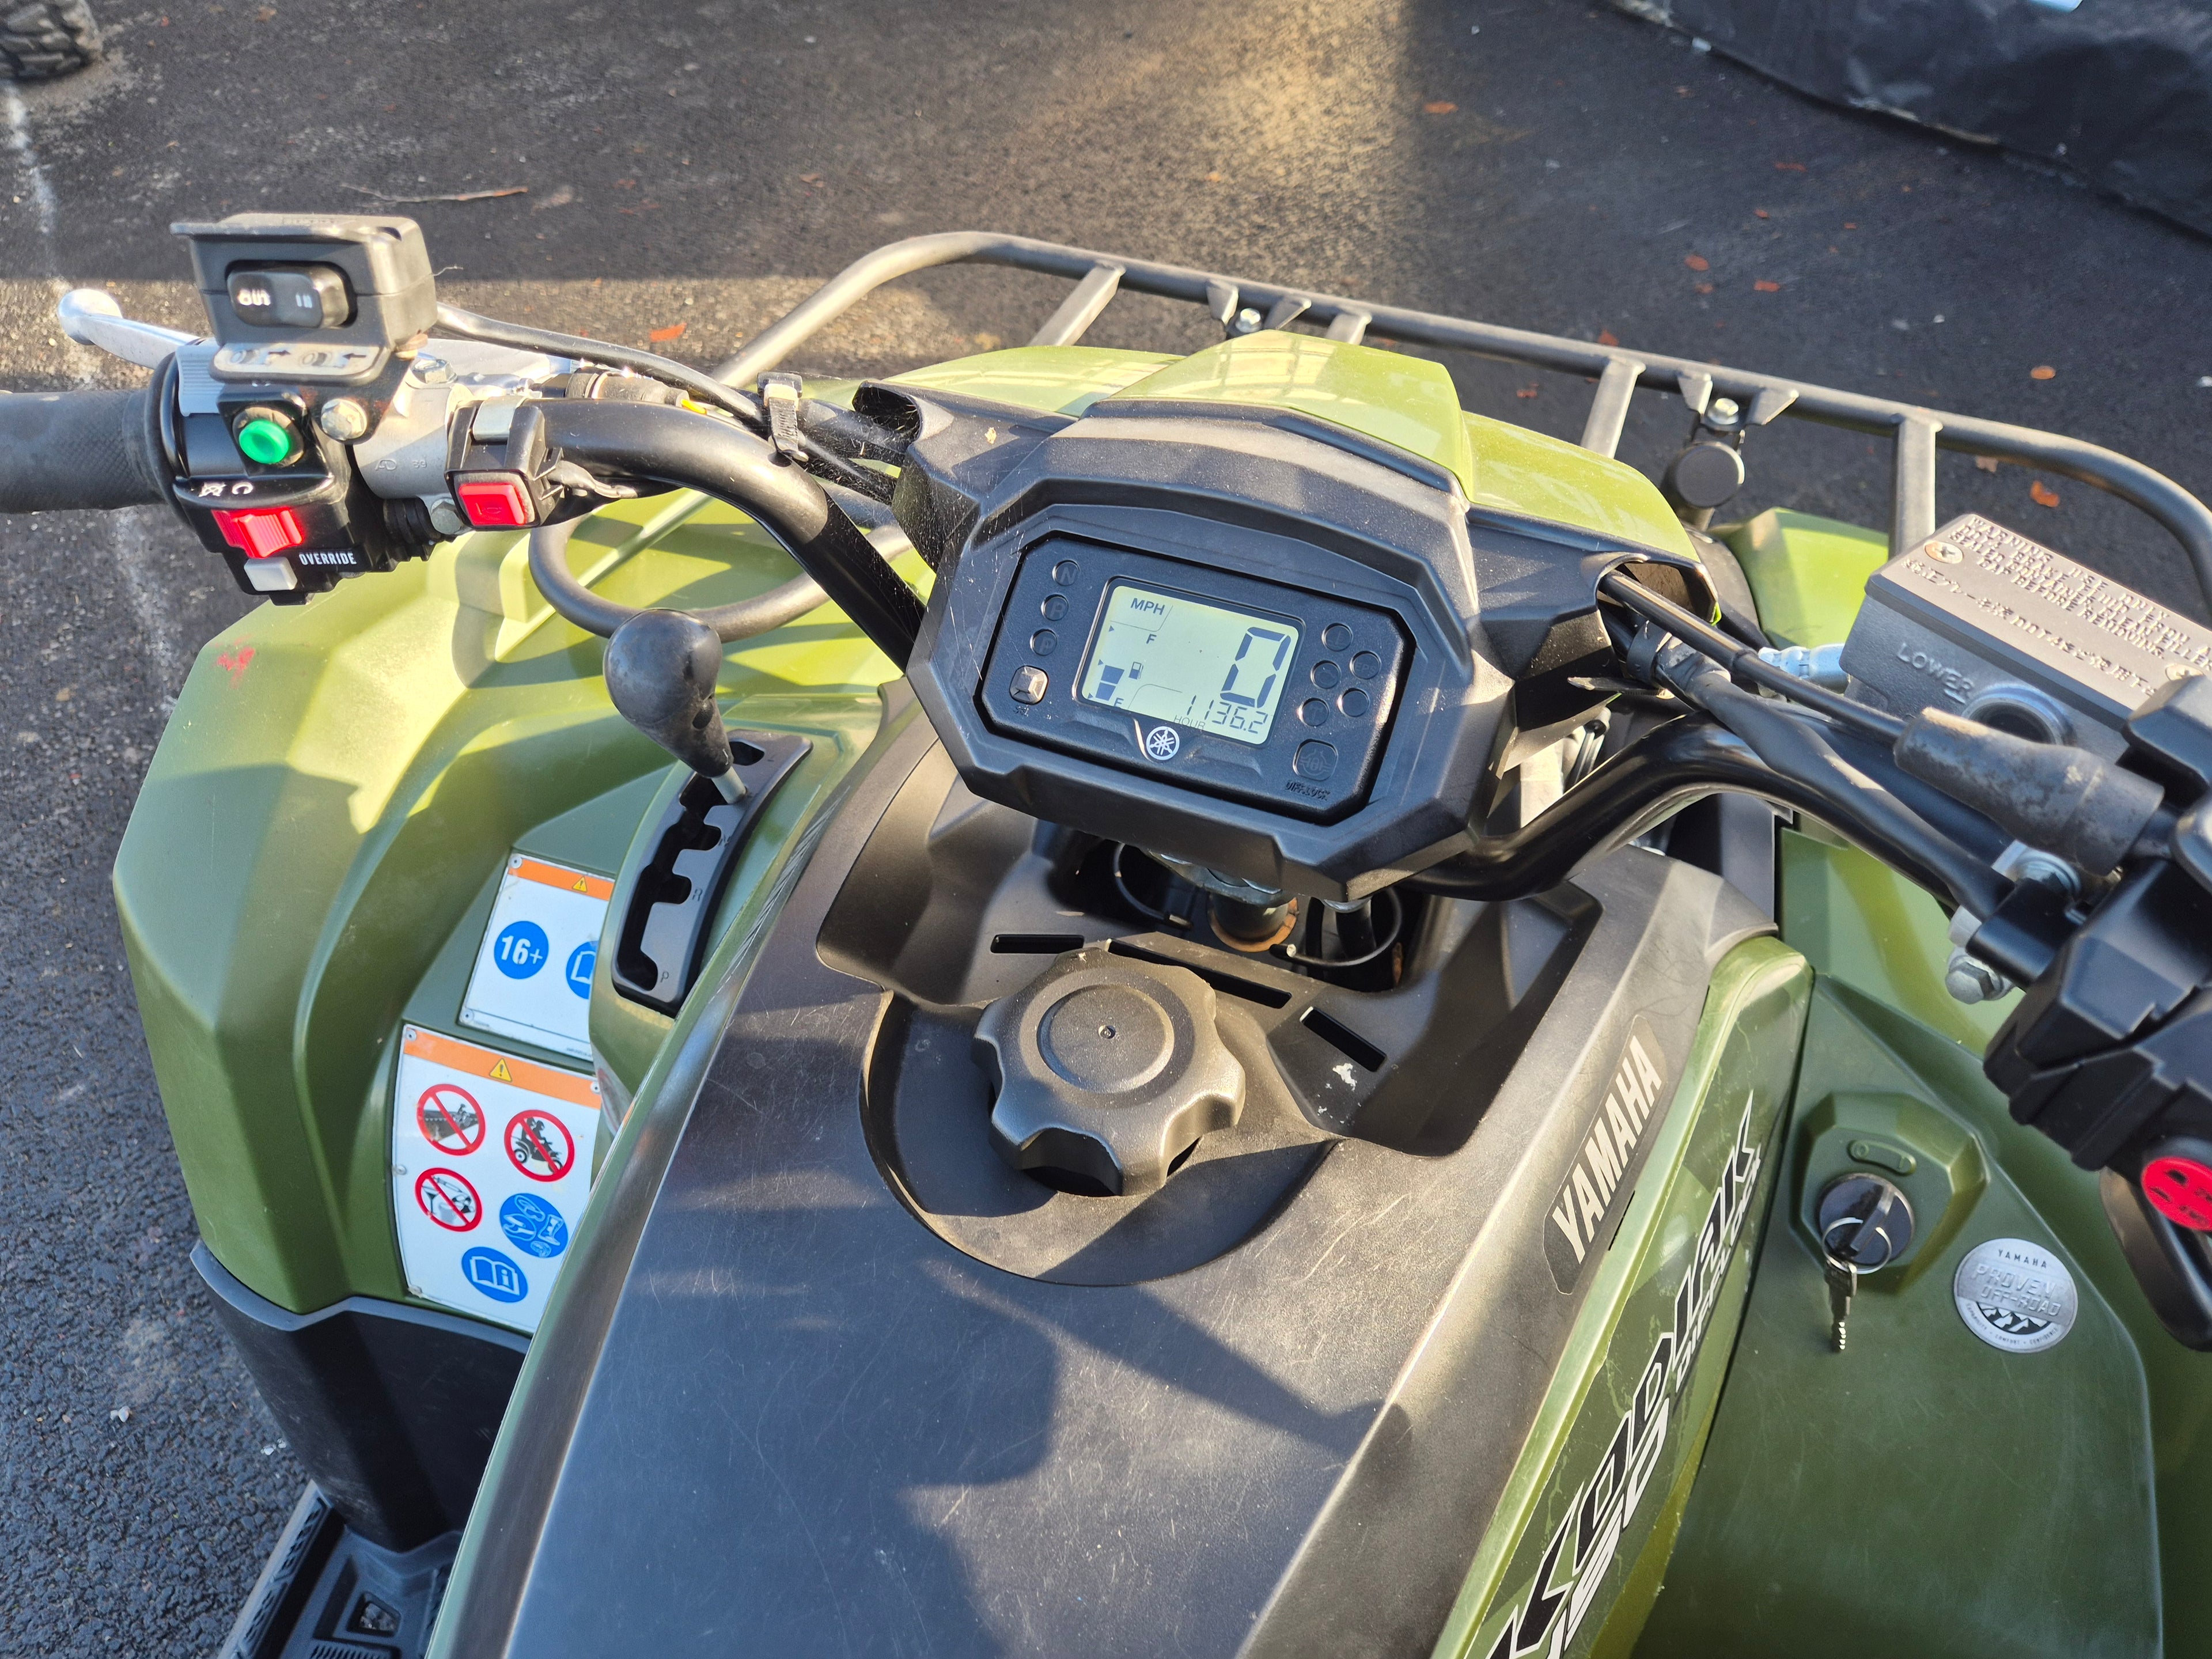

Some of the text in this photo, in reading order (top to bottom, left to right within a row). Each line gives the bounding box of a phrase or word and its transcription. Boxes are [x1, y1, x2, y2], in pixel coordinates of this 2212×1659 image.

[298, 551, 357, 566] OVERRIDE
[1967, 516, 2170, 622] WARNING USE ONLY
[1060, 566, 1077, 584] N
[1948, 530, 2005, 563] SEALED
[2099, 607, 2153, 635] CLEAN
[1956, 524, 2002, 550] DOT4
[2009, 550, 2069, 582] BRAKE
[2076, 582, 2130, 613] FLUID
[2138, 613, 2190, 643] FROM
[1976, 556, 2011, 575] CAP
[2010, 573, 2074, 612] BEFORE
[1050, 601, 1066, 619] R
[1130, 597, 1165, 616] MPH
[1146, 633, 1157, 645] F
[1220, 626, 1291, 709] 0
[1897, 642, 1975, 695] LOWER
[1173, 714, 1206, 730] HOUR
[1186, 694, 1268, 734] 1136.2
[691, 888, 702, 903] R
[500, 935, 543, 965] 16+
[659, 972, 669, 983] P
[1551, 1035, 1662, 1265] YAMAHA
[1998, 1248, 2048, 1269] YAMAHA
[1971, 1263, 2056, 1299] PROVEN
[1980, 1285, 2062, 1317] OFF-ROAD
